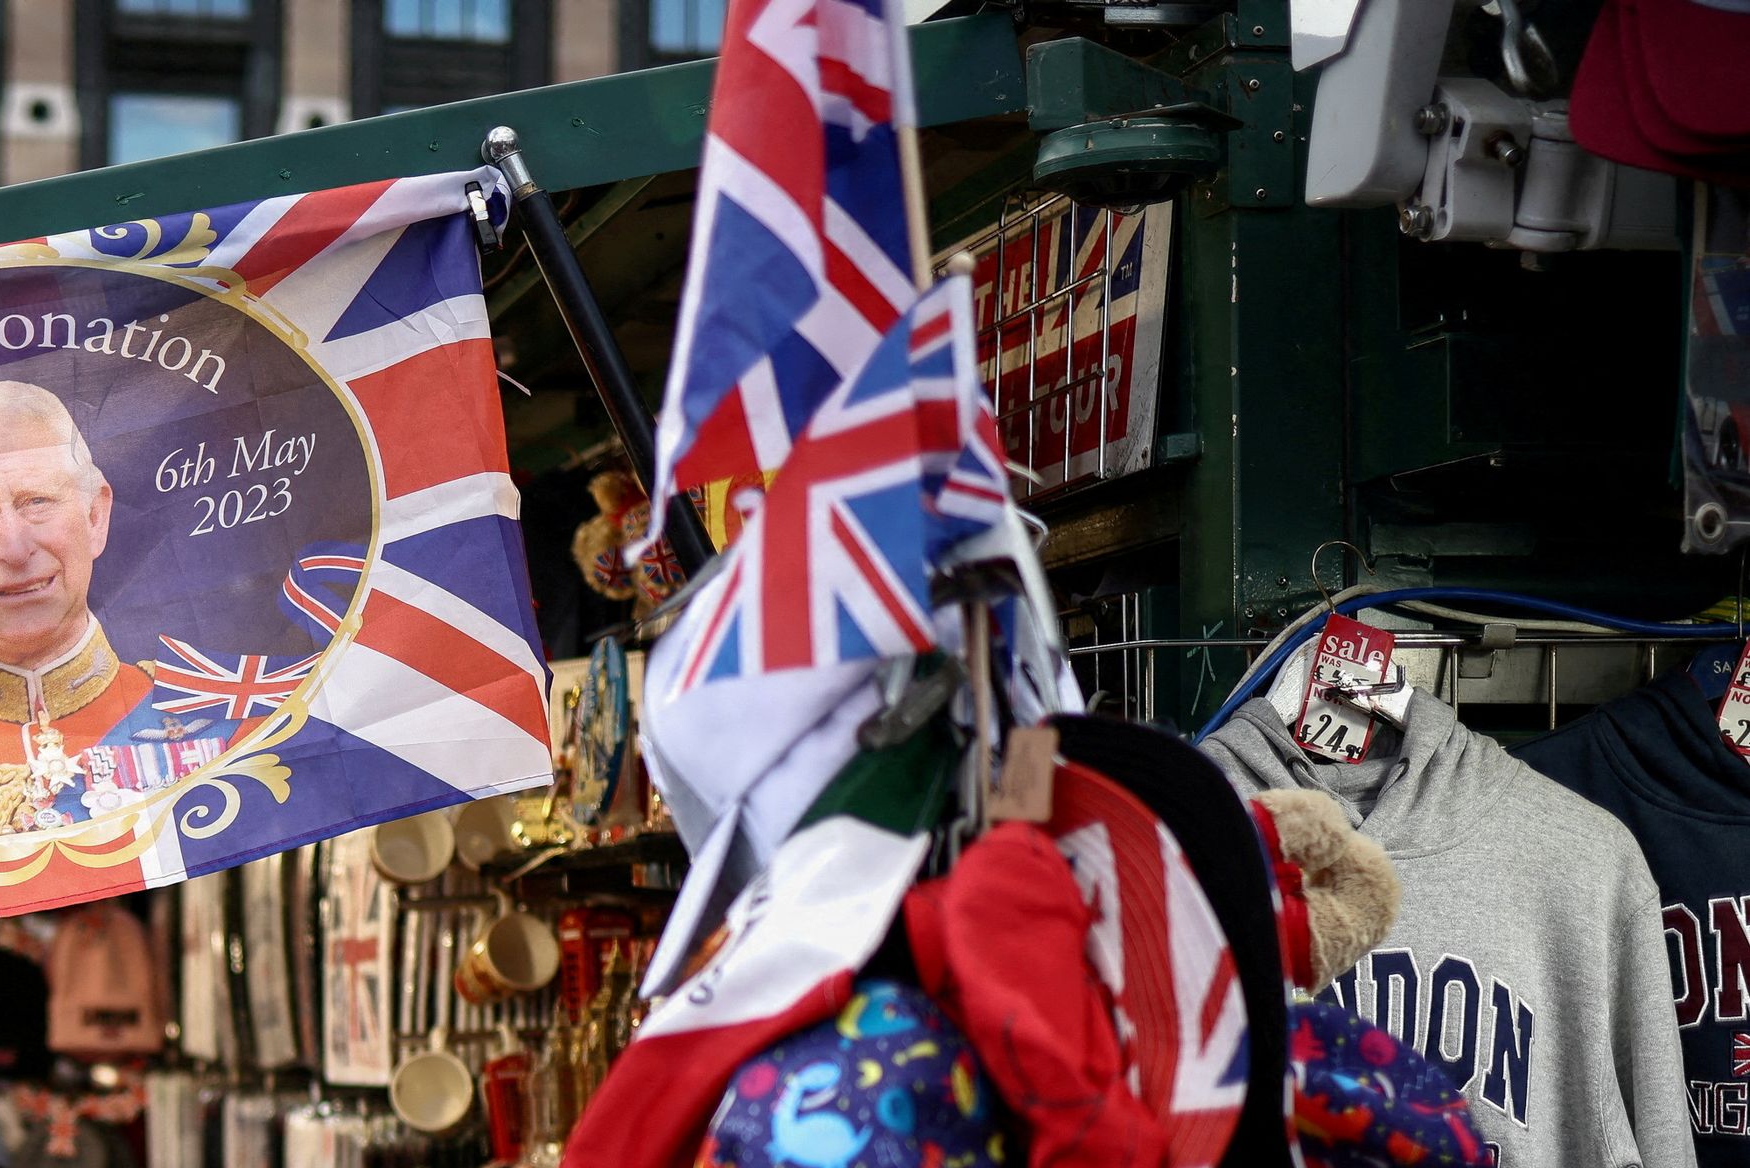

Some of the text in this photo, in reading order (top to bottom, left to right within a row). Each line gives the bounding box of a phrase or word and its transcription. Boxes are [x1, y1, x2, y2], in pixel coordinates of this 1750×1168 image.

[974, 261, 1033, 332] THE
[154, 429, 317, 494] 6th May
[188, 477, 294, 537] 2023
[1321, 654, 1342, 668] WAS
